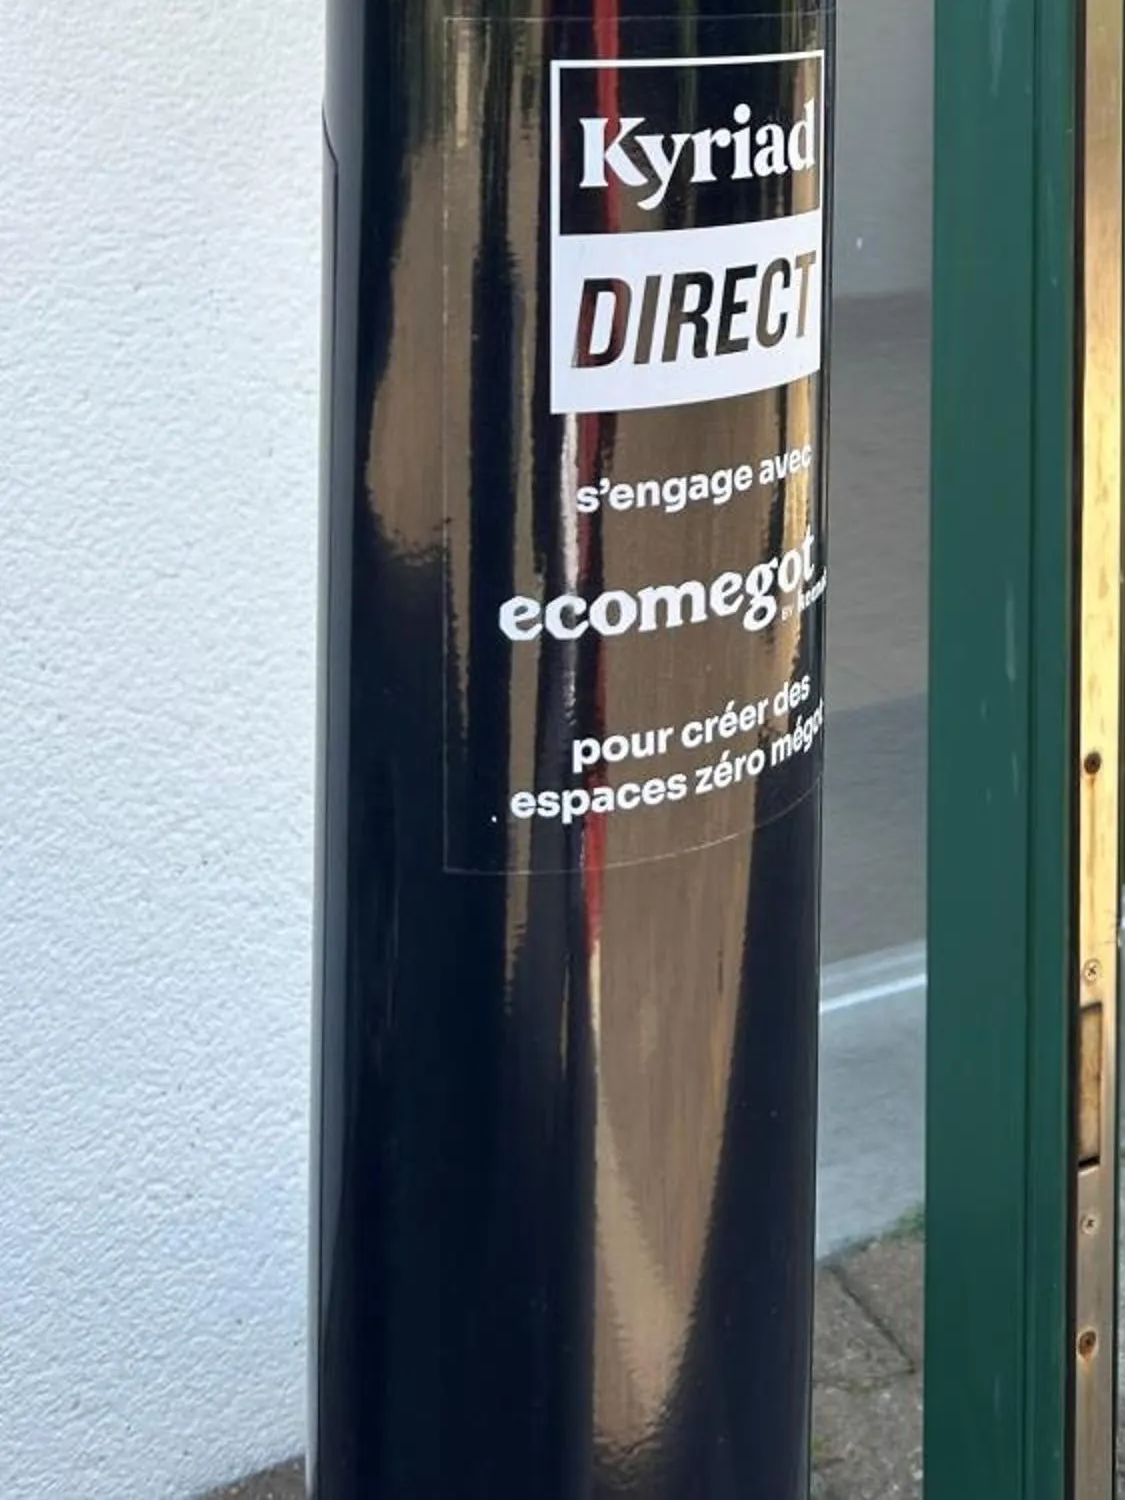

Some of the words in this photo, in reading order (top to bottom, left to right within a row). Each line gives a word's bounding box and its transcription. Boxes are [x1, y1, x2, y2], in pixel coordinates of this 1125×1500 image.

[578, 97, 816, 211] Kyriad
[571, 250, 817, 369] DIRECT
[576, 463, 753, 514] s'engage
[759, 444, 812, 485] avec
[499, 523, 815, 641] ecomegot
[572, 726, 674, 775] pour
[681, 696, 769, 749] créer
[773, 674, 811, 717] des
[510, 773, 687, 825] espaces
[695, 749, 766, 795] zéro
